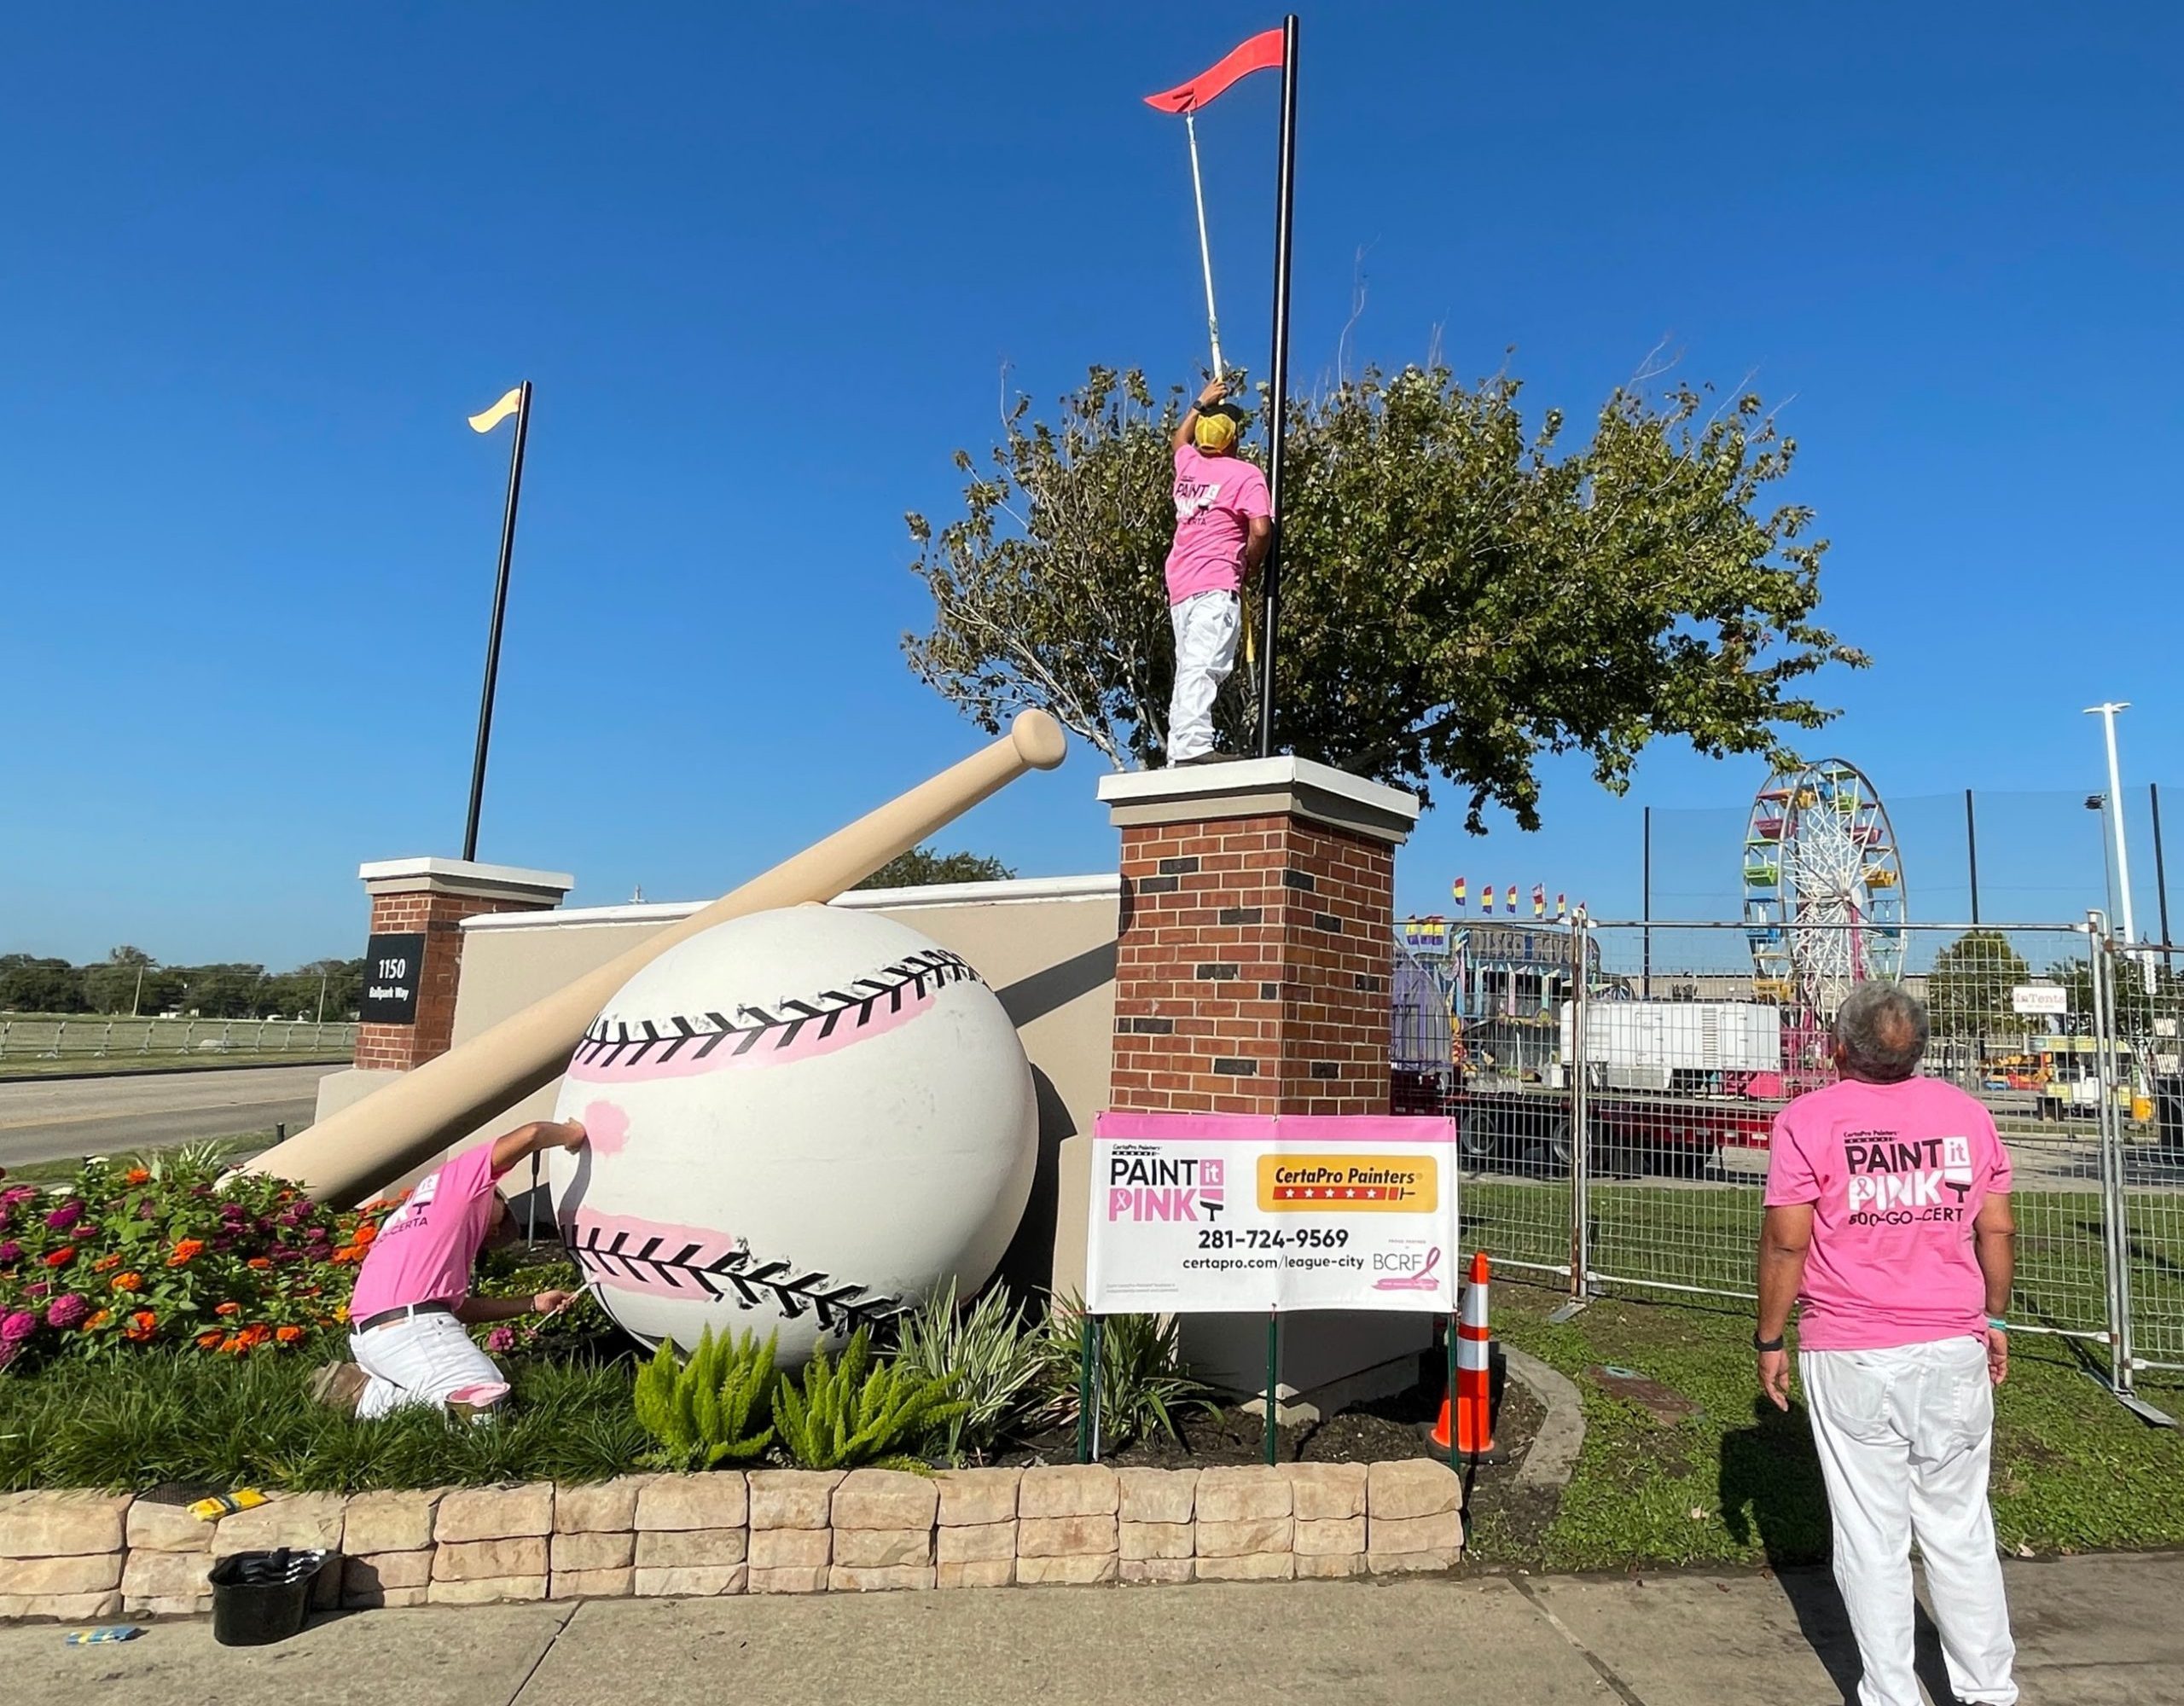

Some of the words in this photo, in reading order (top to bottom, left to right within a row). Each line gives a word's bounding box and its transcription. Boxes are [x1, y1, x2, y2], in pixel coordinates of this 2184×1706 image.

[1472, 930, 1525, 960] DISCO
[379, 958, 406, 979] 1150
[1844, 1138, 1943, 1175] PAINT
[1949, 1141, 1966, 1163] it
[1110, 1158, 1199, 1186] PAINT
[1205, 1162, 1219, 1183] it
[1275, 1167, 1344, 1183] CertaPro
[1348, 1167, 1414, 1184] Painters
[1848, 1169, 1944, 1211] PINK
[1109, 1188, 1199, 1221] PINK
[1198, 1229, 1349, 1249] 281-724-9569
[1182, 1255, 1365, 1272] certapro.com/league-city
[1373, 1253, 1423, 1271] BCRF
